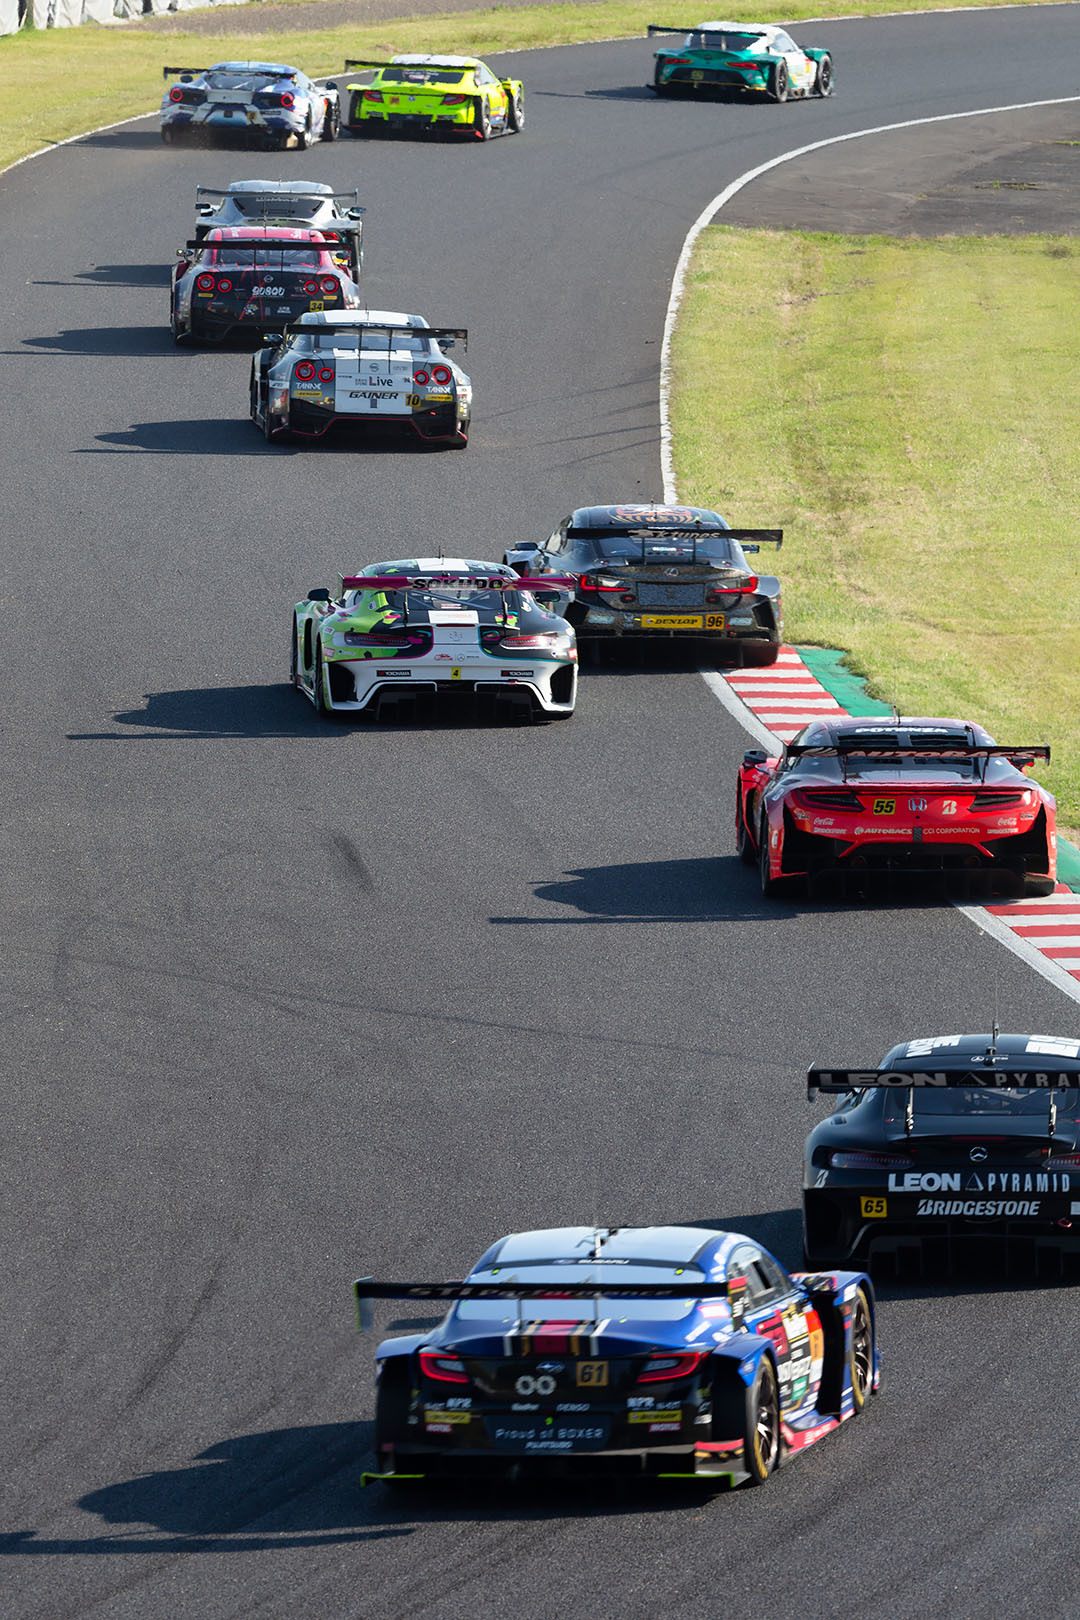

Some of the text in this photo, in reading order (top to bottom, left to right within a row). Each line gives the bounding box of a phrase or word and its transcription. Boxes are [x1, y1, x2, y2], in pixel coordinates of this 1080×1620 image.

[310, 302, 323, 311] 34
[369, 376, 393, 387] Live
[349, 391, 399, 400] GAINER
[406, 394, 420, 406] 10
[707, 616, 723, 627] 96
[874, 800, 895, 814] 55
[819, 1072, 1080, 1087] LEON PYRA
[888, 1172, 1070, 1192] LEON PYRAMID
[864, 1200, 884, 1213] 65
[916, 1199, 1041, 1216] BRIDGESTONE
[580, 1364, 605, 1383] 61
[556, 1403, 590, 1412] DENSO
[495, 1428, 536, 1439] Proud
[557, 1428, 604, 1439] BOXER
